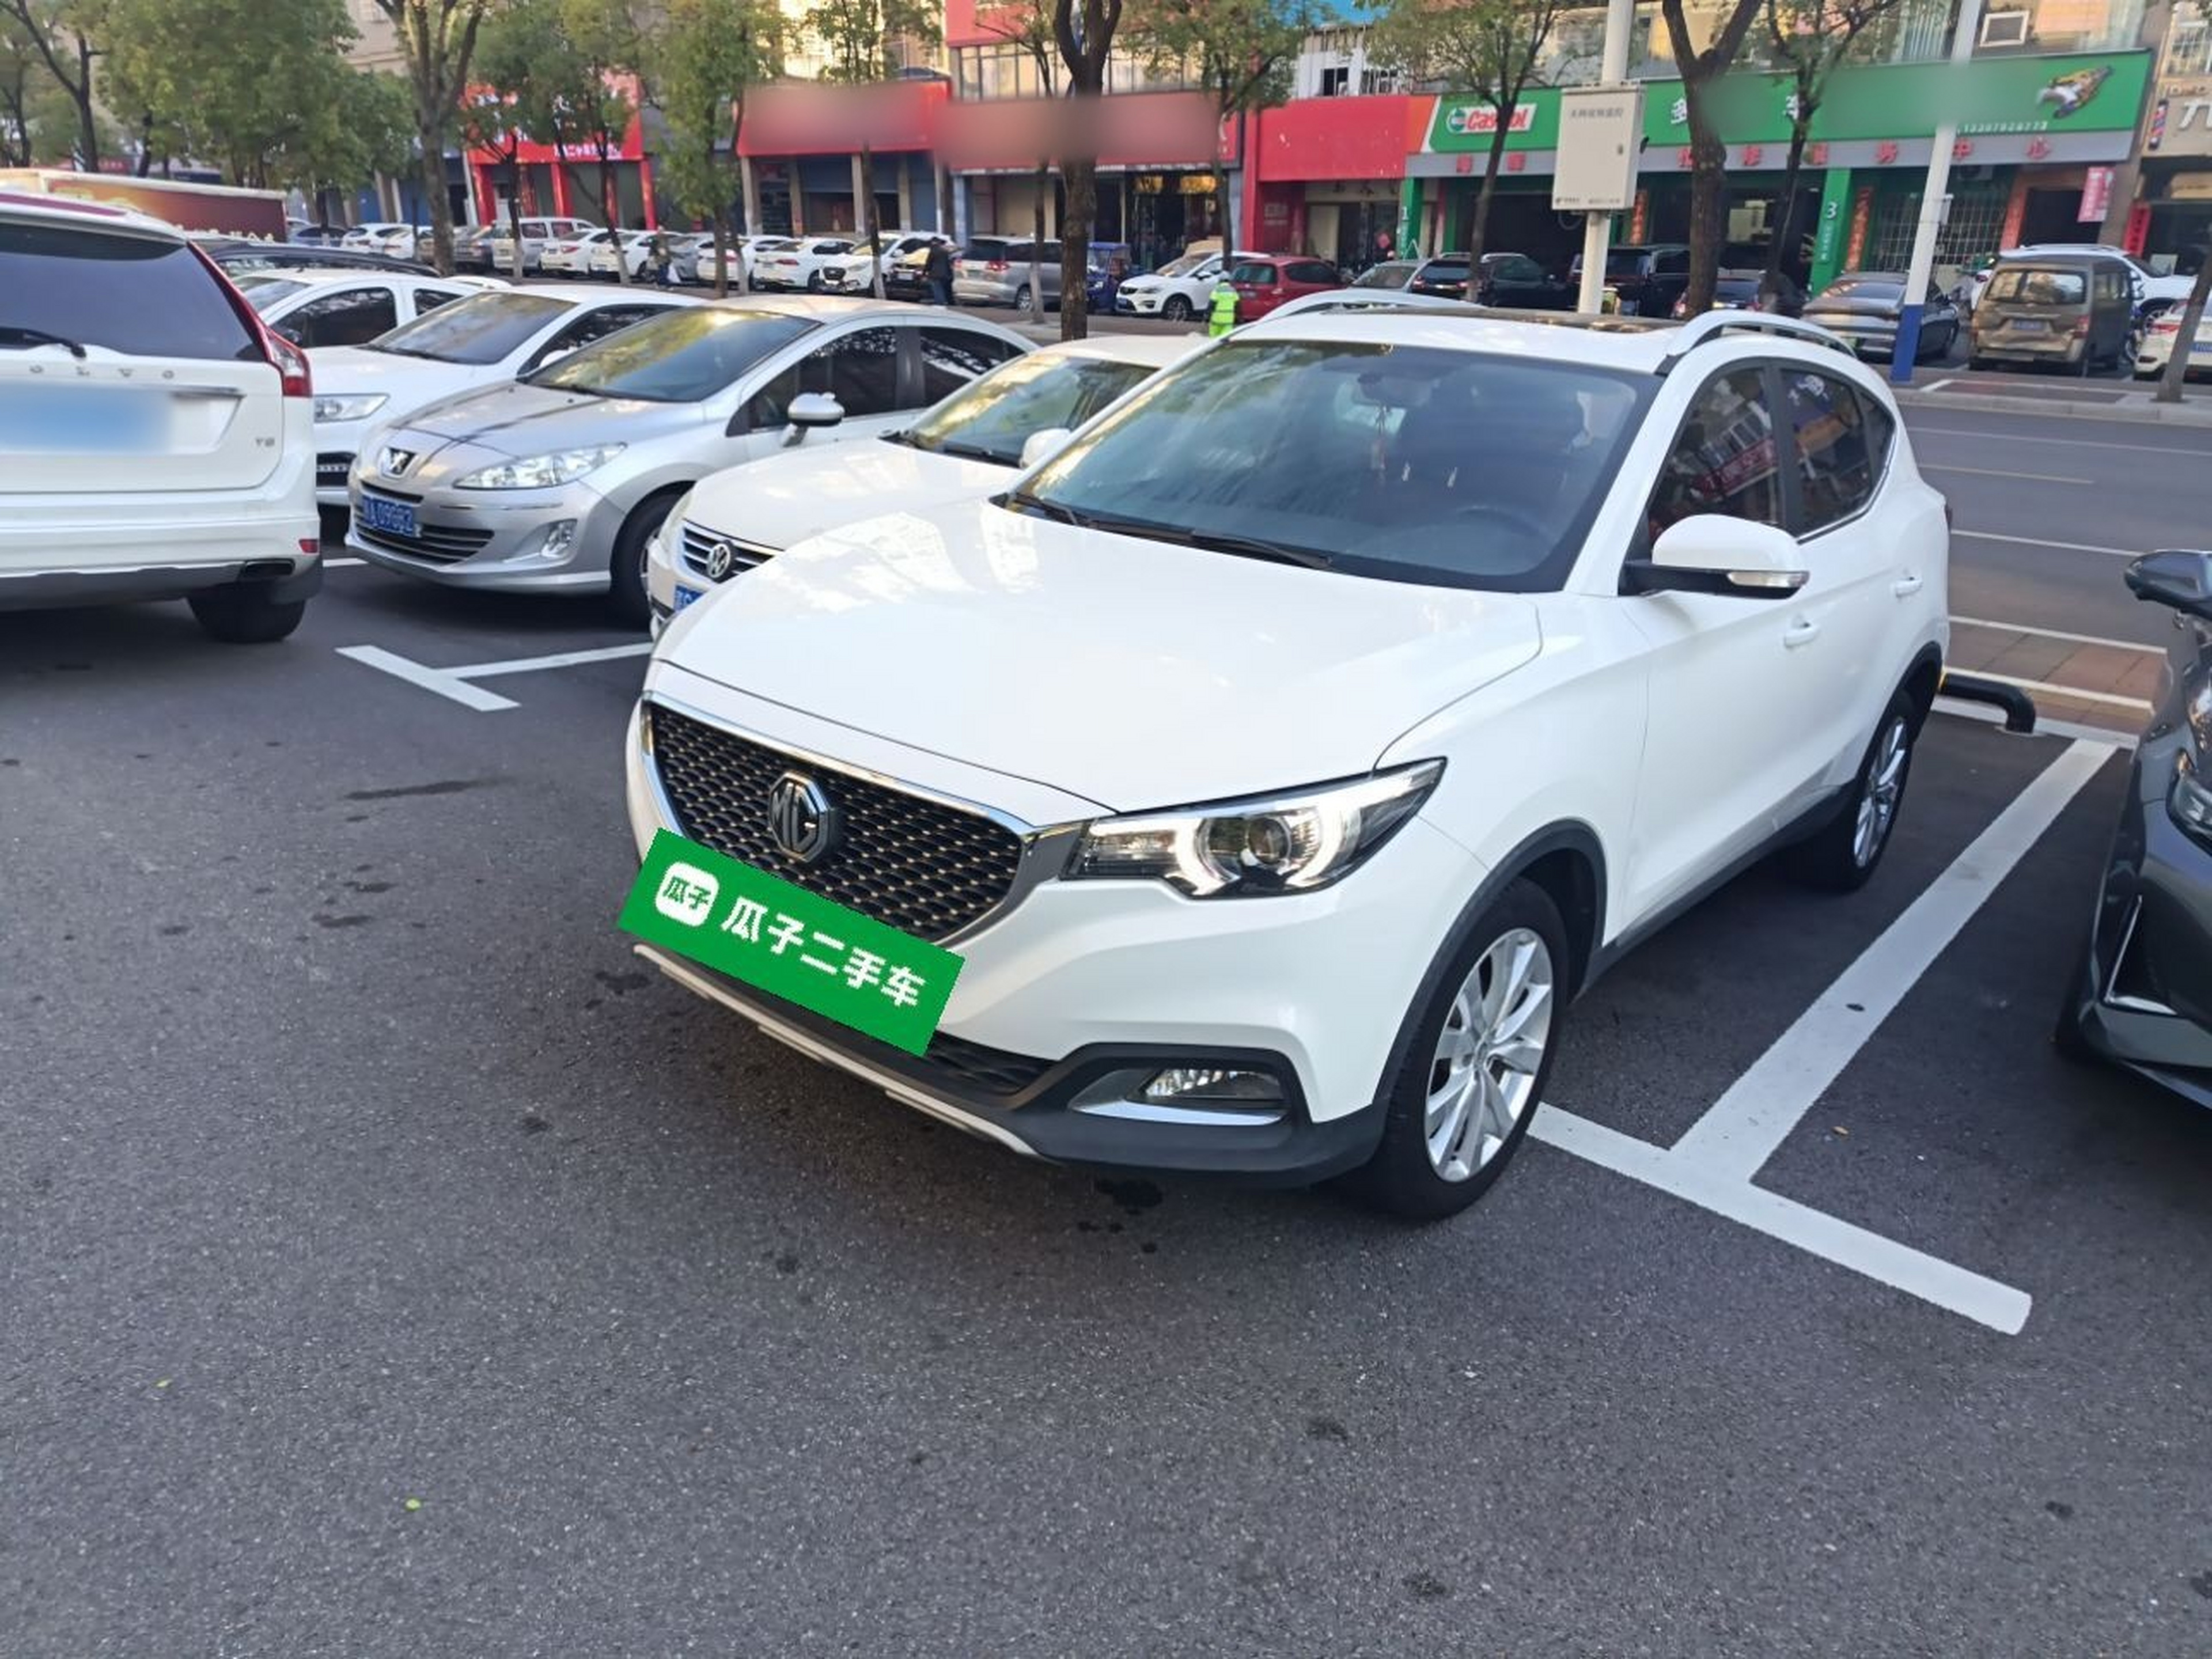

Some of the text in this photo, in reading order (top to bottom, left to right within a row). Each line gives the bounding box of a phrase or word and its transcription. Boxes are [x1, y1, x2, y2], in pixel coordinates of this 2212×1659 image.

[1467, 109, 1528, 130] Casol
[1827, 201, 1838, 219] 3
[772, 781, 817, 853] MG
